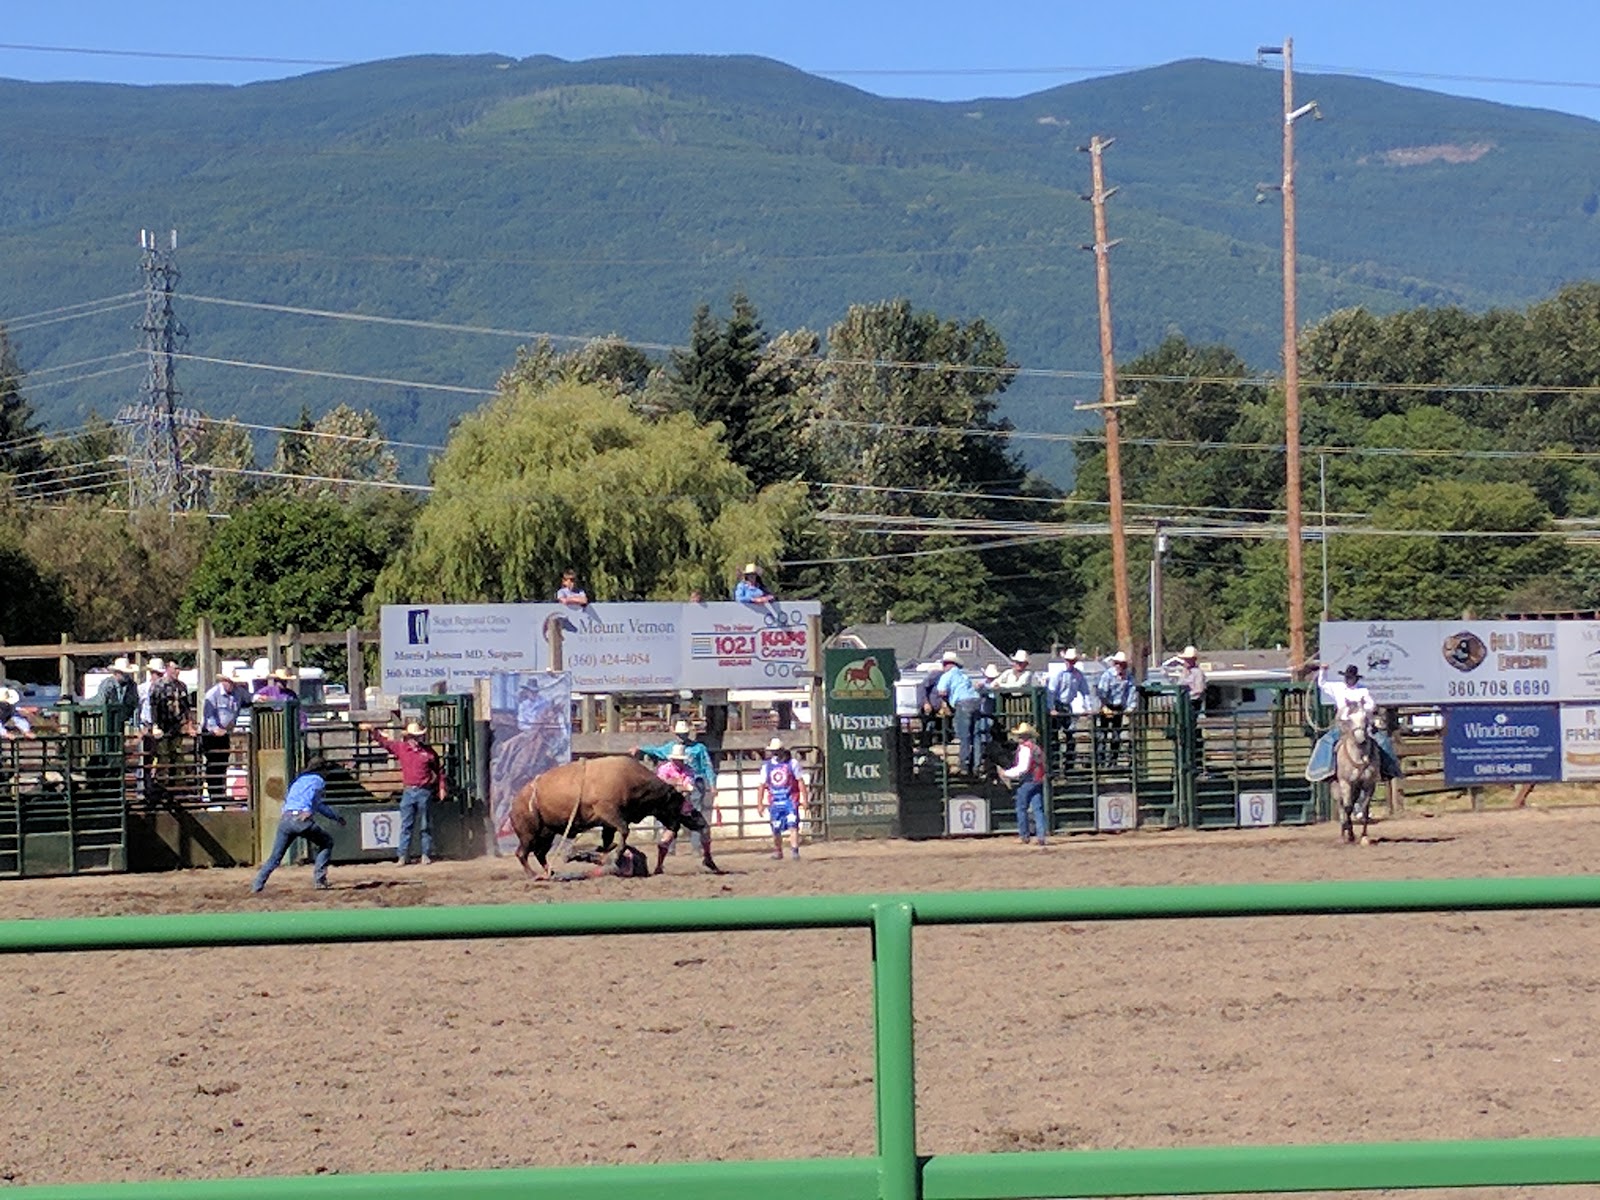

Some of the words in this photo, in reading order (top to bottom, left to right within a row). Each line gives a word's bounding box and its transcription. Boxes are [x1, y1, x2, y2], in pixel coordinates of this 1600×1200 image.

[578, 618, 625, 634] Mount
[628, 618, 675, 634] Vernon
[713, 624, 732, 632] The
[1489, 631, 1516, 652] GOLD
[425, 650, 462, 661] Johnson
[568, 653, 598, 668] (360)
[761, 647, 807, 659] Country
[829, 714, 893, 730] WESTERN
[1464, 722, 1540, 739] Windermere
[841, 734, 882, 750] WEAR
[843, 762, 881, 779] TACK
